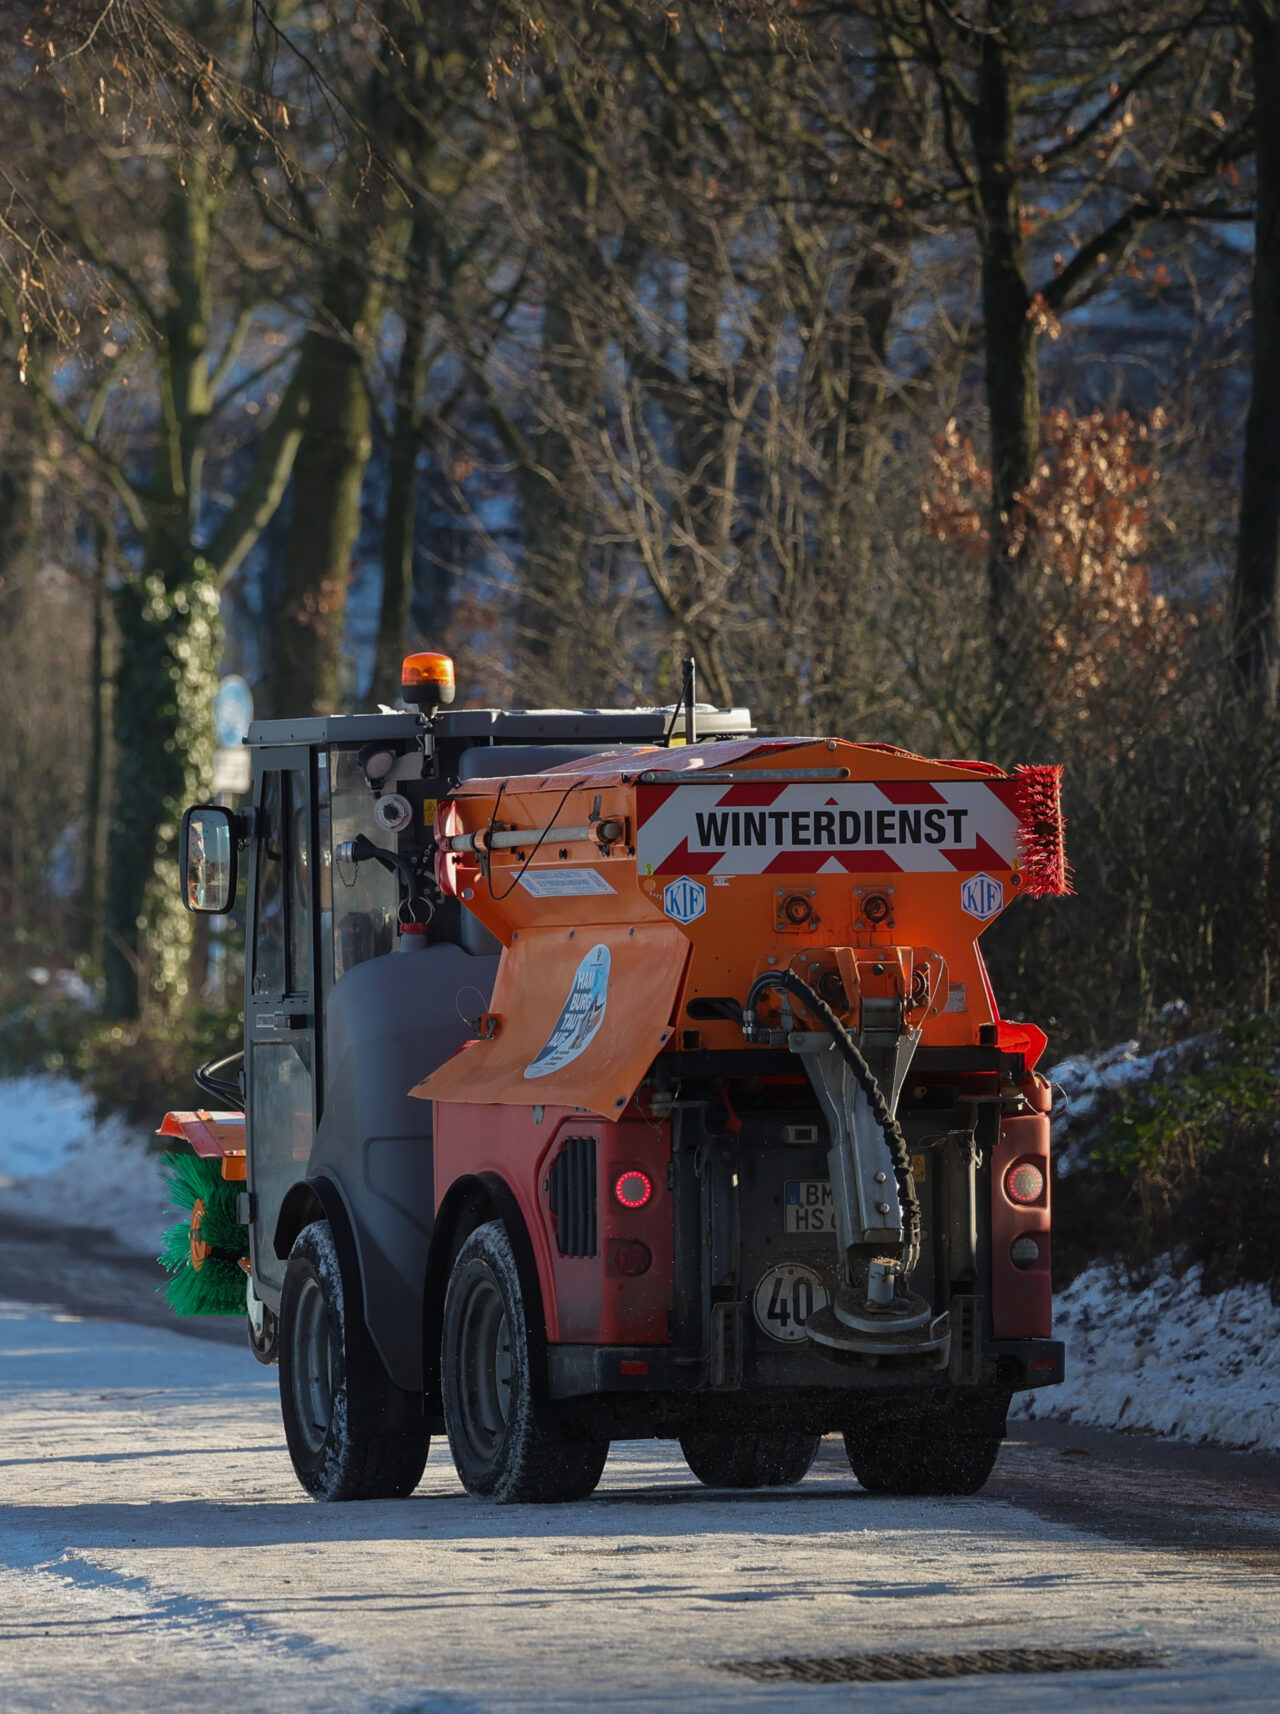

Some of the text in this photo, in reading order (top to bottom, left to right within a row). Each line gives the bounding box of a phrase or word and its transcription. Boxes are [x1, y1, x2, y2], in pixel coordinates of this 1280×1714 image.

[695, 808, 968, 847] WINTERDIENST
[670, 882, 701, 917] KIF
[967, 879, 998, 914] KIF
[577, 971, 595, 989] HAM
[569, 993, 593, 1011] BURG
[560, 1012, 584, 1031] TAUT
[547, 1031, 569, 1048] AUF
[806, 1184, 833, 1206] BM
[767, 1276, 814, 1327] 40
